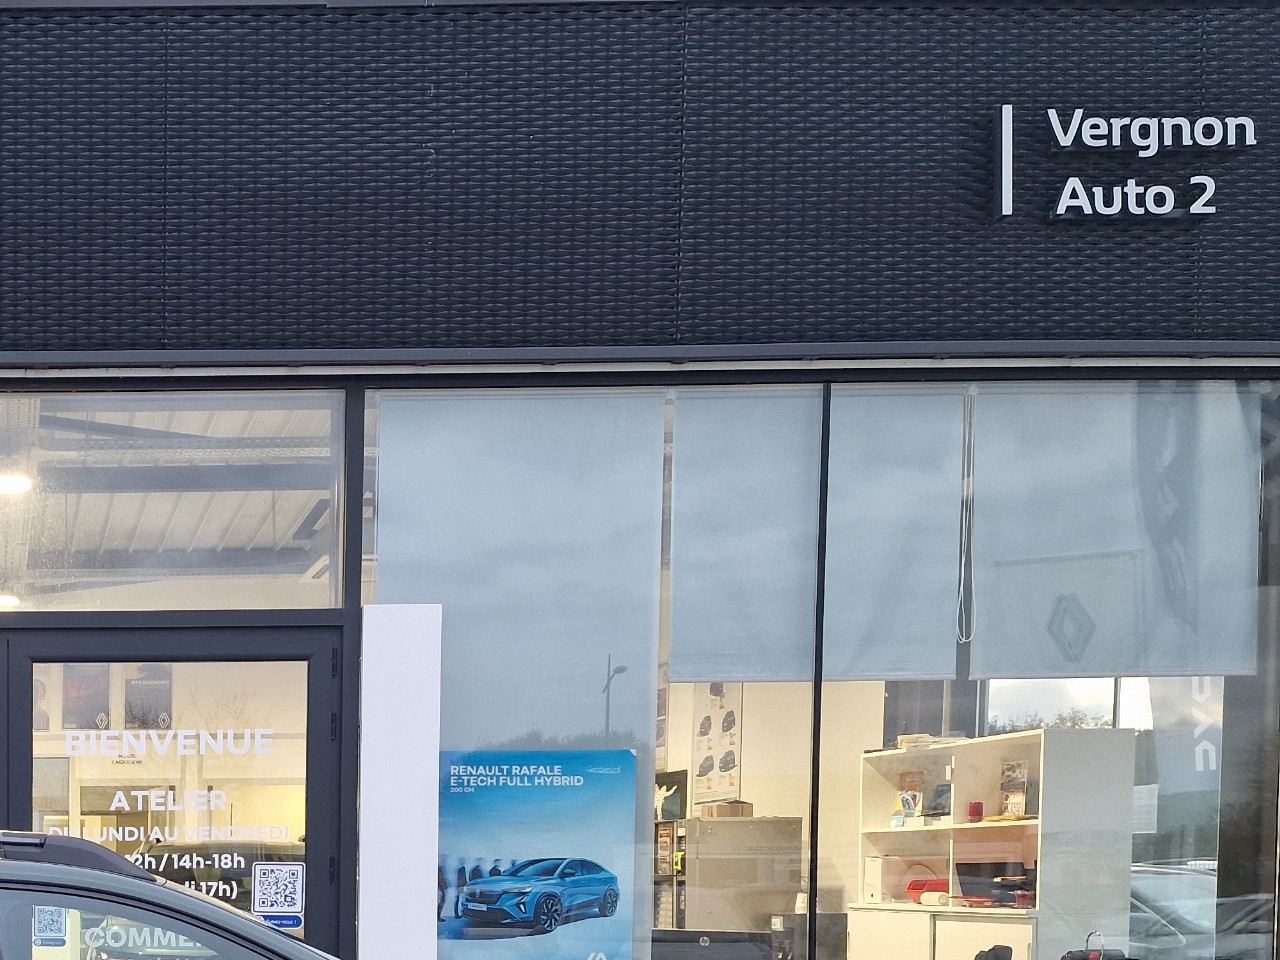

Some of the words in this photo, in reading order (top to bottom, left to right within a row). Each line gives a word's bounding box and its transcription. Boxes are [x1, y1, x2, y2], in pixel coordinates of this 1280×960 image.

[1047, 108, 1258, 158] Vergnon
[1056, 177, 1175, 215] Auto
[1189, 175, 1217, 214] 2
[65, 729, 273, 756] BIENVENUE
[450, 765, 510, 776] RENAULT
[511, 765, 562, 776] RAFALE
[450, 776, 497, 787] E-TECH
[499, 776, 532, 787] FULL
[534, 776, 584, 786] HYBRID
[110, 790, 227, 812] ATELIER
[82, 826, 145, 842] LUNDI
[150, 825, 177, 841] AU
[183, 825, 289, 842] VENDREDI
[171, 852, 245, 869] 14h-18h
[84, 927, 202, 948] COMME
